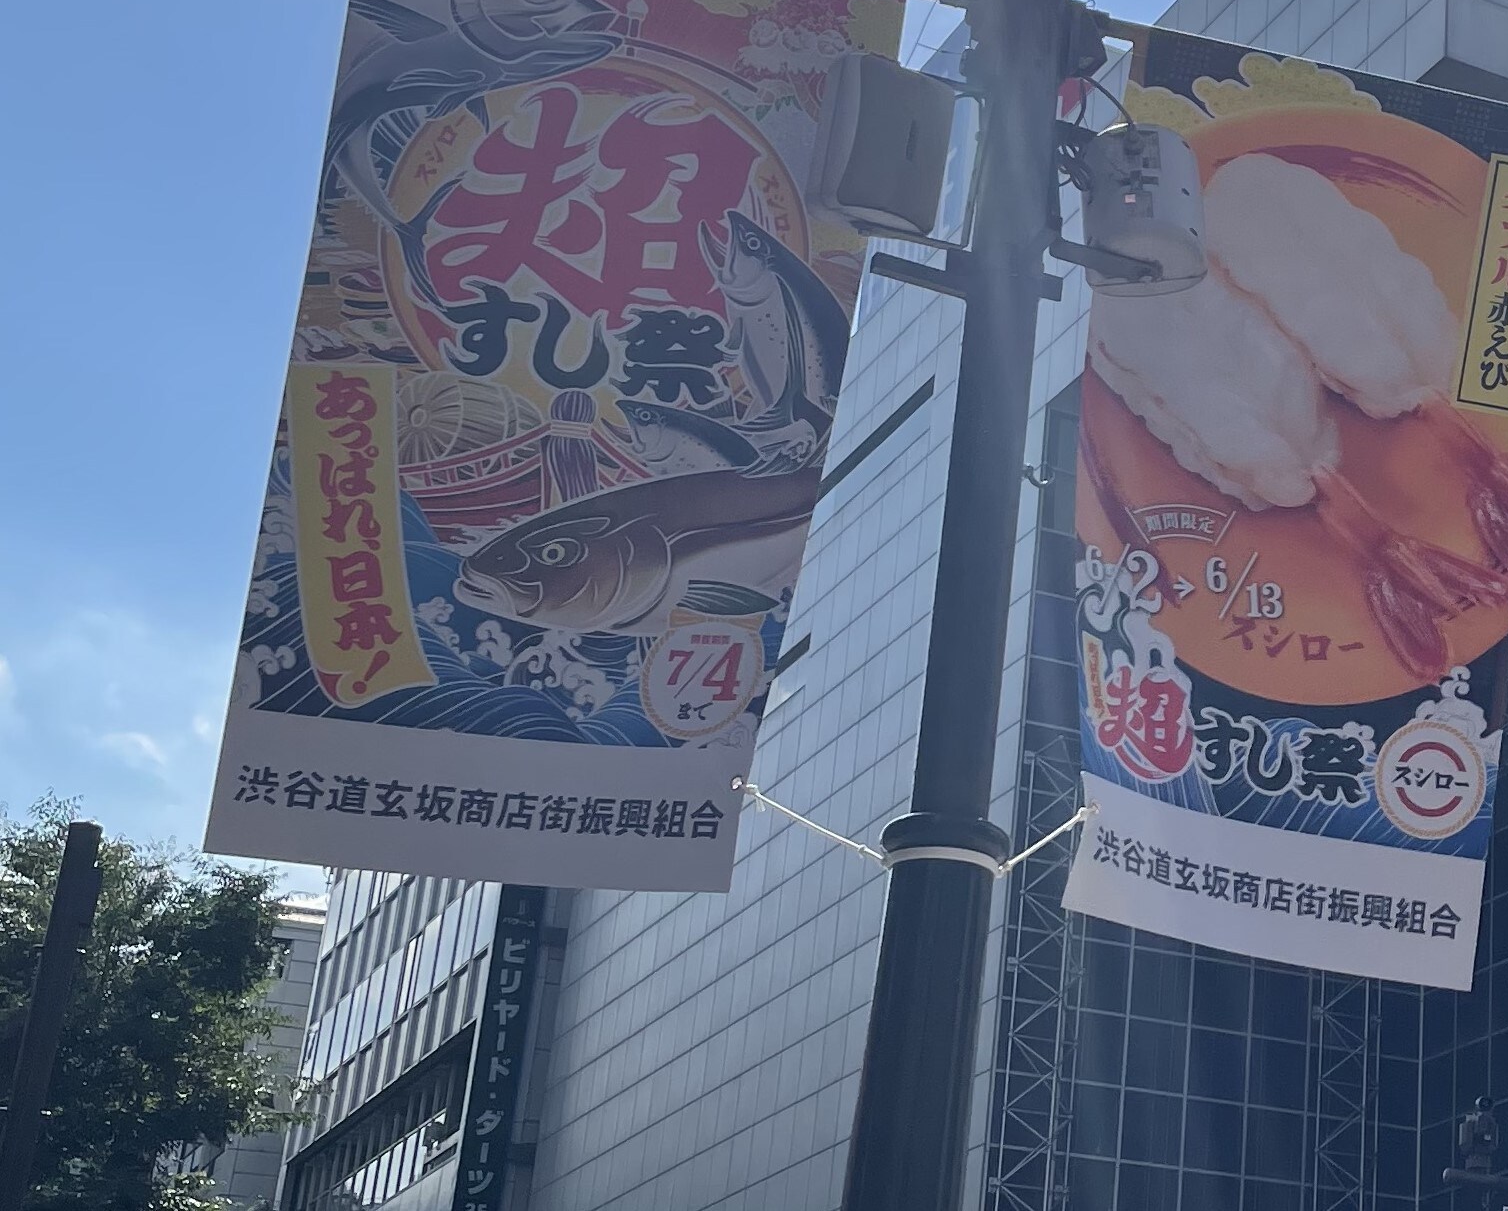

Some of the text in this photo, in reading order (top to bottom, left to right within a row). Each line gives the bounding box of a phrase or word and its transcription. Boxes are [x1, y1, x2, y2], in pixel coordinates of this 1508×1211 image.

[414, 116, 466, 184] スシロー
[442, 281, 727, 405] すし祭
[666, 642, 744, 701] 7/4
[1223, 616, 1365, 662] スシロー
[233, 765, 725, 839] 渋谷道玄坂商店街振興組合
[1391, 764, 1470, 789] スシロー
[1093, 826, 1462, 940] 渋谷道玄坂商店街振興組合
